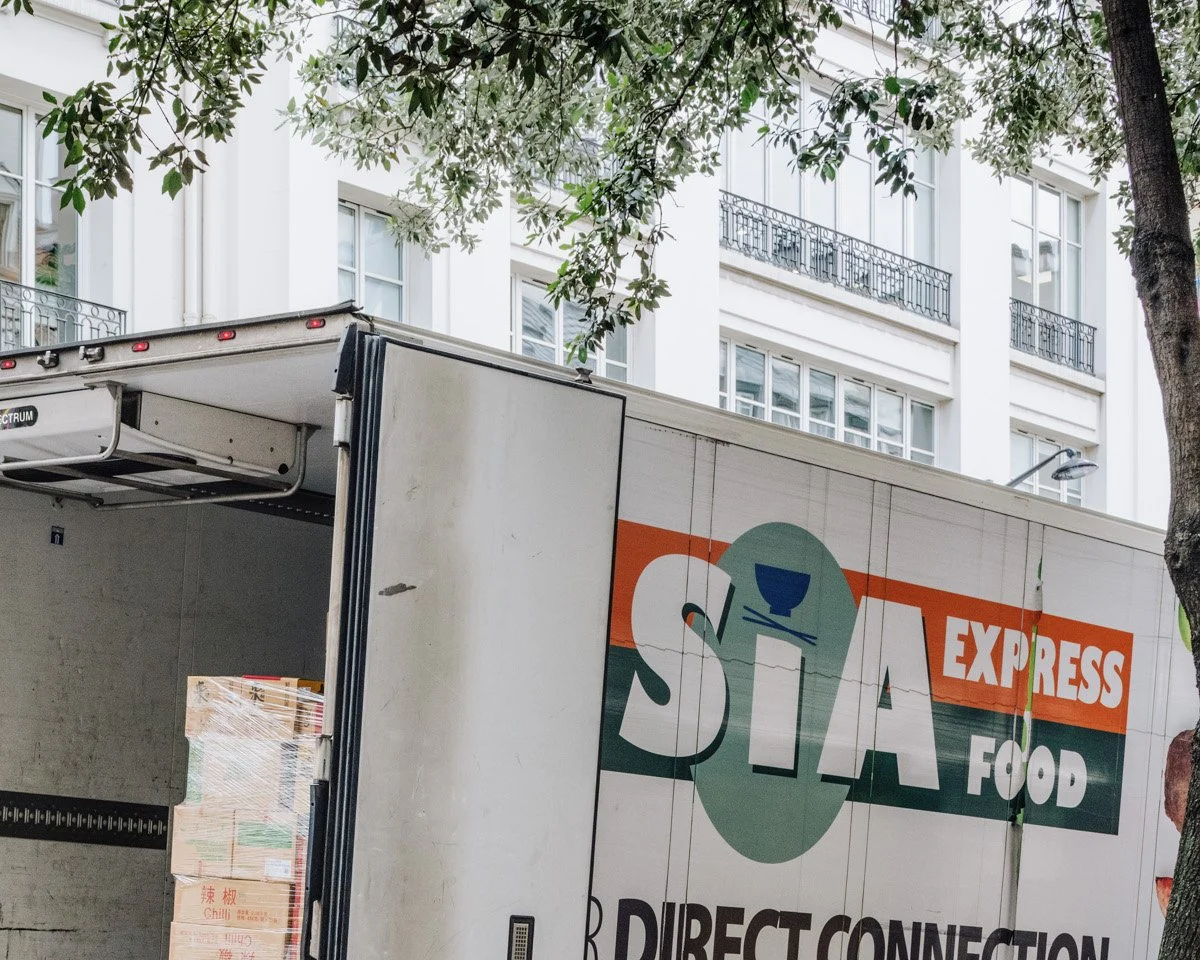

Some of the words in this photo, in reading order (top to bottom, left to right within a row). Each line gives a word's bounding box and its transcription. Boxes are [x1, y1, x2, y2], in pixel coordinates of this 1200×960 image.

[942, 615, 1125, 709] EXPRESS
[967, 734, 1088, 808] FOOD
[203, 906, 232, 920] Chilli
